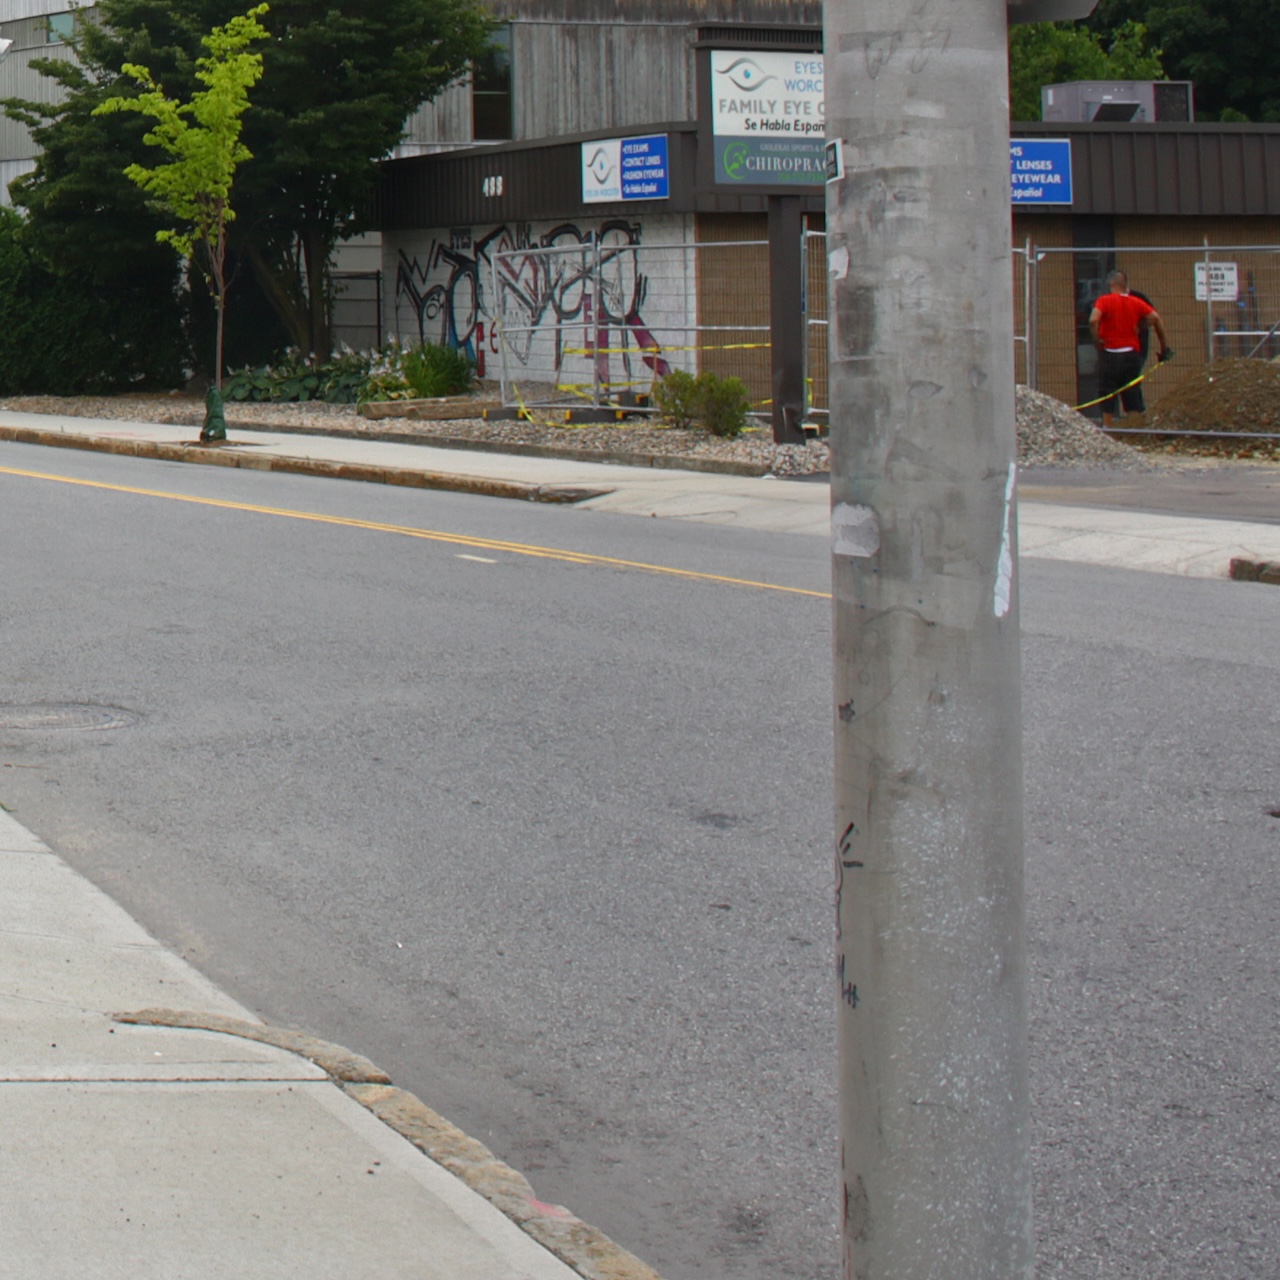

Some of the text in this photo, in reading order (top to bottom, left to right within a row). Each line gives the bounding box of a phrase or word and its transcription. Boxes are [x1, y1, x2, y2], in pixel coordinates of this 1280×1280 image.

[794, 61, 824, 75] EYES
[784, 80, 824, 93] WORC
[719, 99, 777, 114] FAMILY
[783, 101, 812, 115] EYE
[744, 118, 826, 135] Se Habla Españ
[1016, 160, 1053, 170] LENSES
[1011, 173, 1062, 184] EYEWEAR
[482, 175, 503, 198] 488
[1011, 187, 1043, 199] spañol
